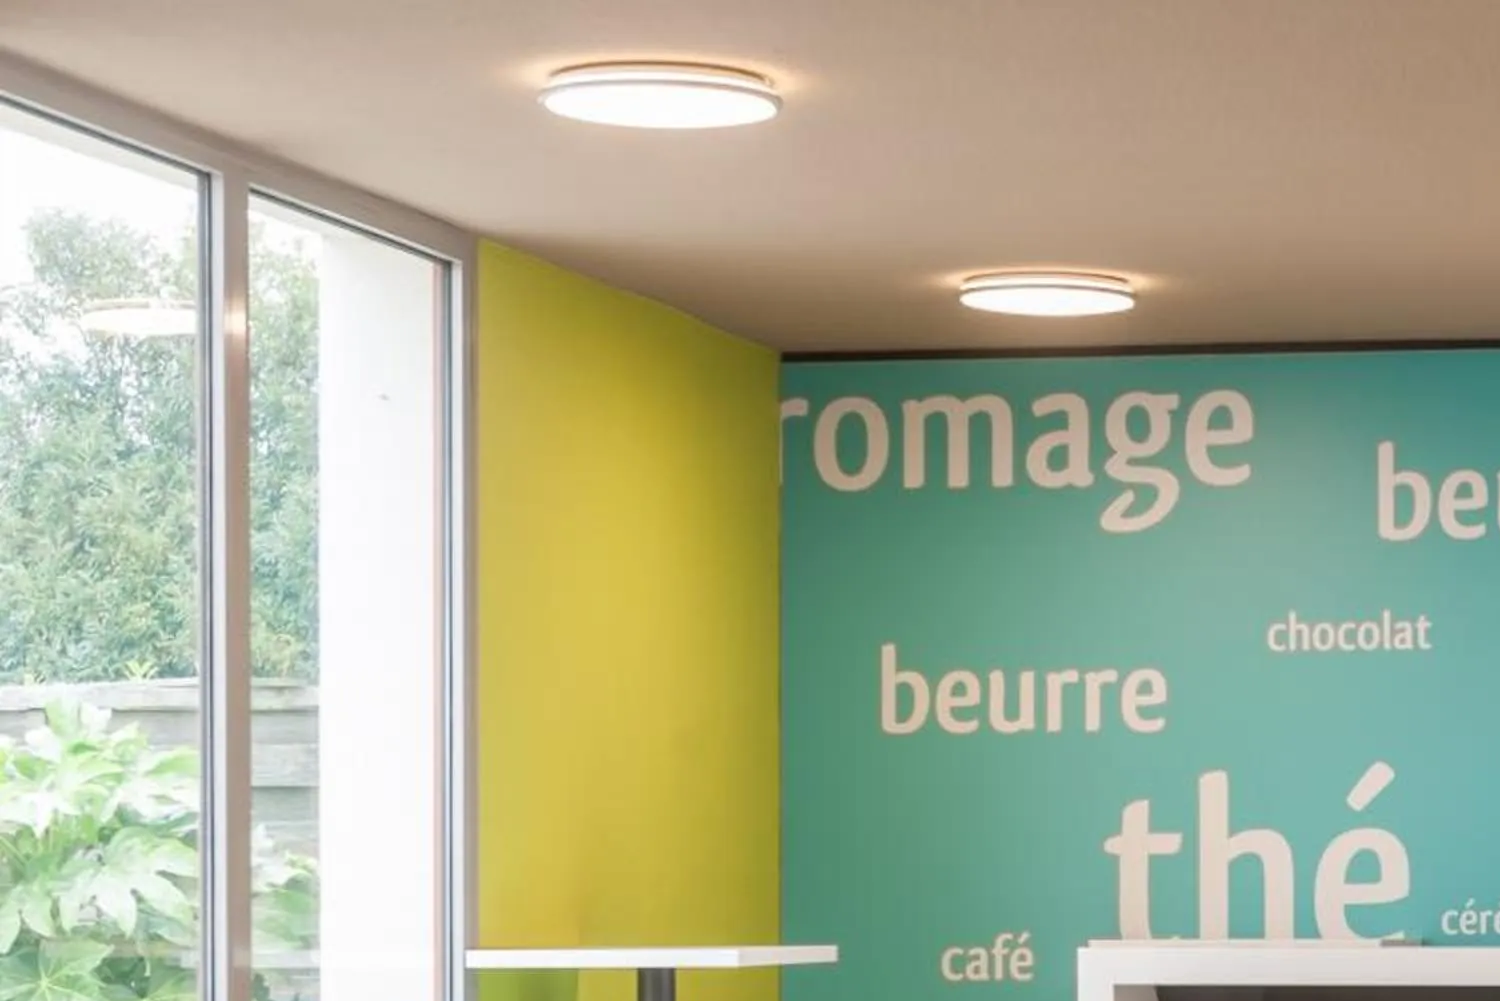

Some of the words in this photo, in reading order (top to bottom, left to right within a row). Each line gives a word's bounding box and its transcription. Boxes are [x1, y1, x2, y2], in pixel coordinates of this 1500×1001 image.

[1265, 608, 1432, 653] chocolat
[879, 642, 1169, 736] beurre
[1103, 761, 1410, 940] thé
[939, 932, 1036, 983] café
